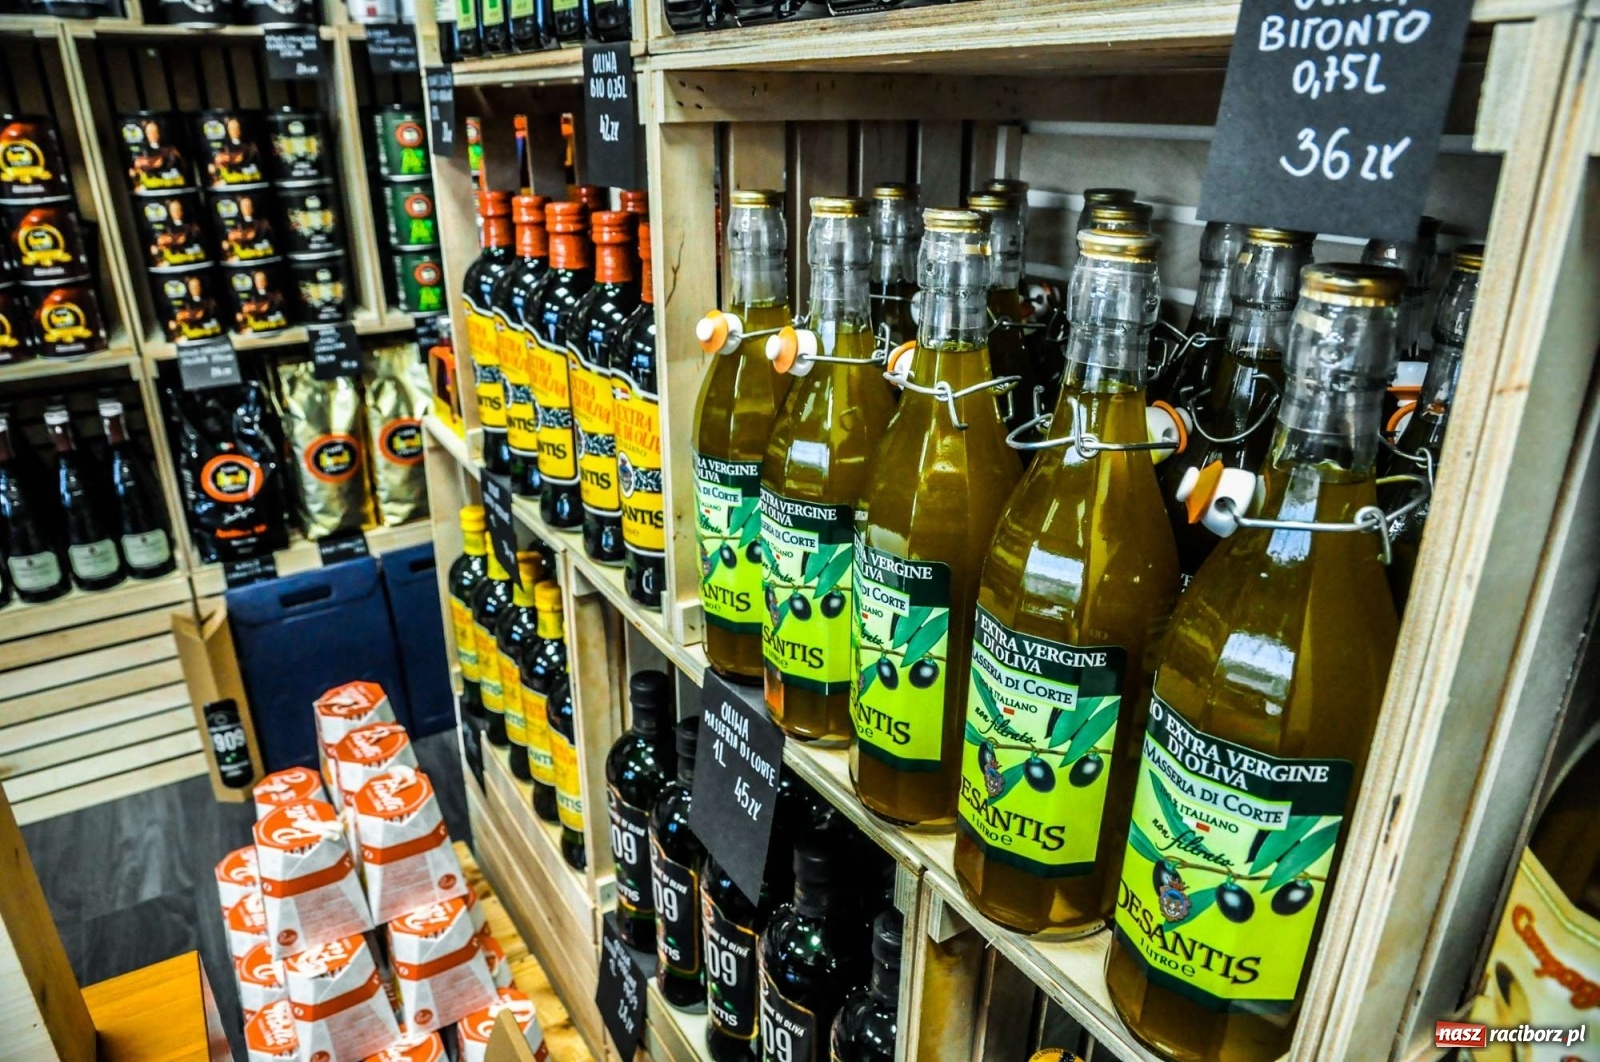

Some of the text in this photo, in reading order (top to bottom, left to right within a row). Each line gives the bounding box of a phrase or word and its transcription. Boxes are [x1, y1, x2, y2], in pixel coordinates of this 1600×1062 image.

[1258, 9, 1431, 51] BITONTO
[593, 51, 617, 74] OLIWA
[1292, 52, 1386, 100] 0,75L
[590, 77, 605, 98] BIO
[1280, 127, 1350, 181] 36
[708, 459, 759, 476] VERGINE
[768, 506, 793, 527] OLIVA
[780, 501, 838, 520] VERGINE
[870, 552, 933, 580] VERGINE
[980, 614, 1107, 668] EXTRA VERGINE
[983, 632, 1043, 675] DI OLIVA
[1005, 676, 1019, 691] DI
[994, 691, 1038, 714] ITALIANO
[720, 701, 749, 742] OLIWA
[704, 709, 776, 788] MASSERIA DI CORTE
[1165, 713, 1221, 763] EXTRA
[1226, 748, 1330, 782] VERGINE
[1167, 735, 1249, 790] DI OLIVA
[1200, 788, 1219, 805] DI
[1152, 818, 1170, 839] non
[1180, 803, 1239, 833] ITALIANO
[653, 877, 679, 923] 09
[1117, 877, 1262, 984] DESANTIS
[707, 939, 738, 987] 09
[1146, 944, 1179, 970] LITRO
[783, 1018, 806, 1038] OLIVA
